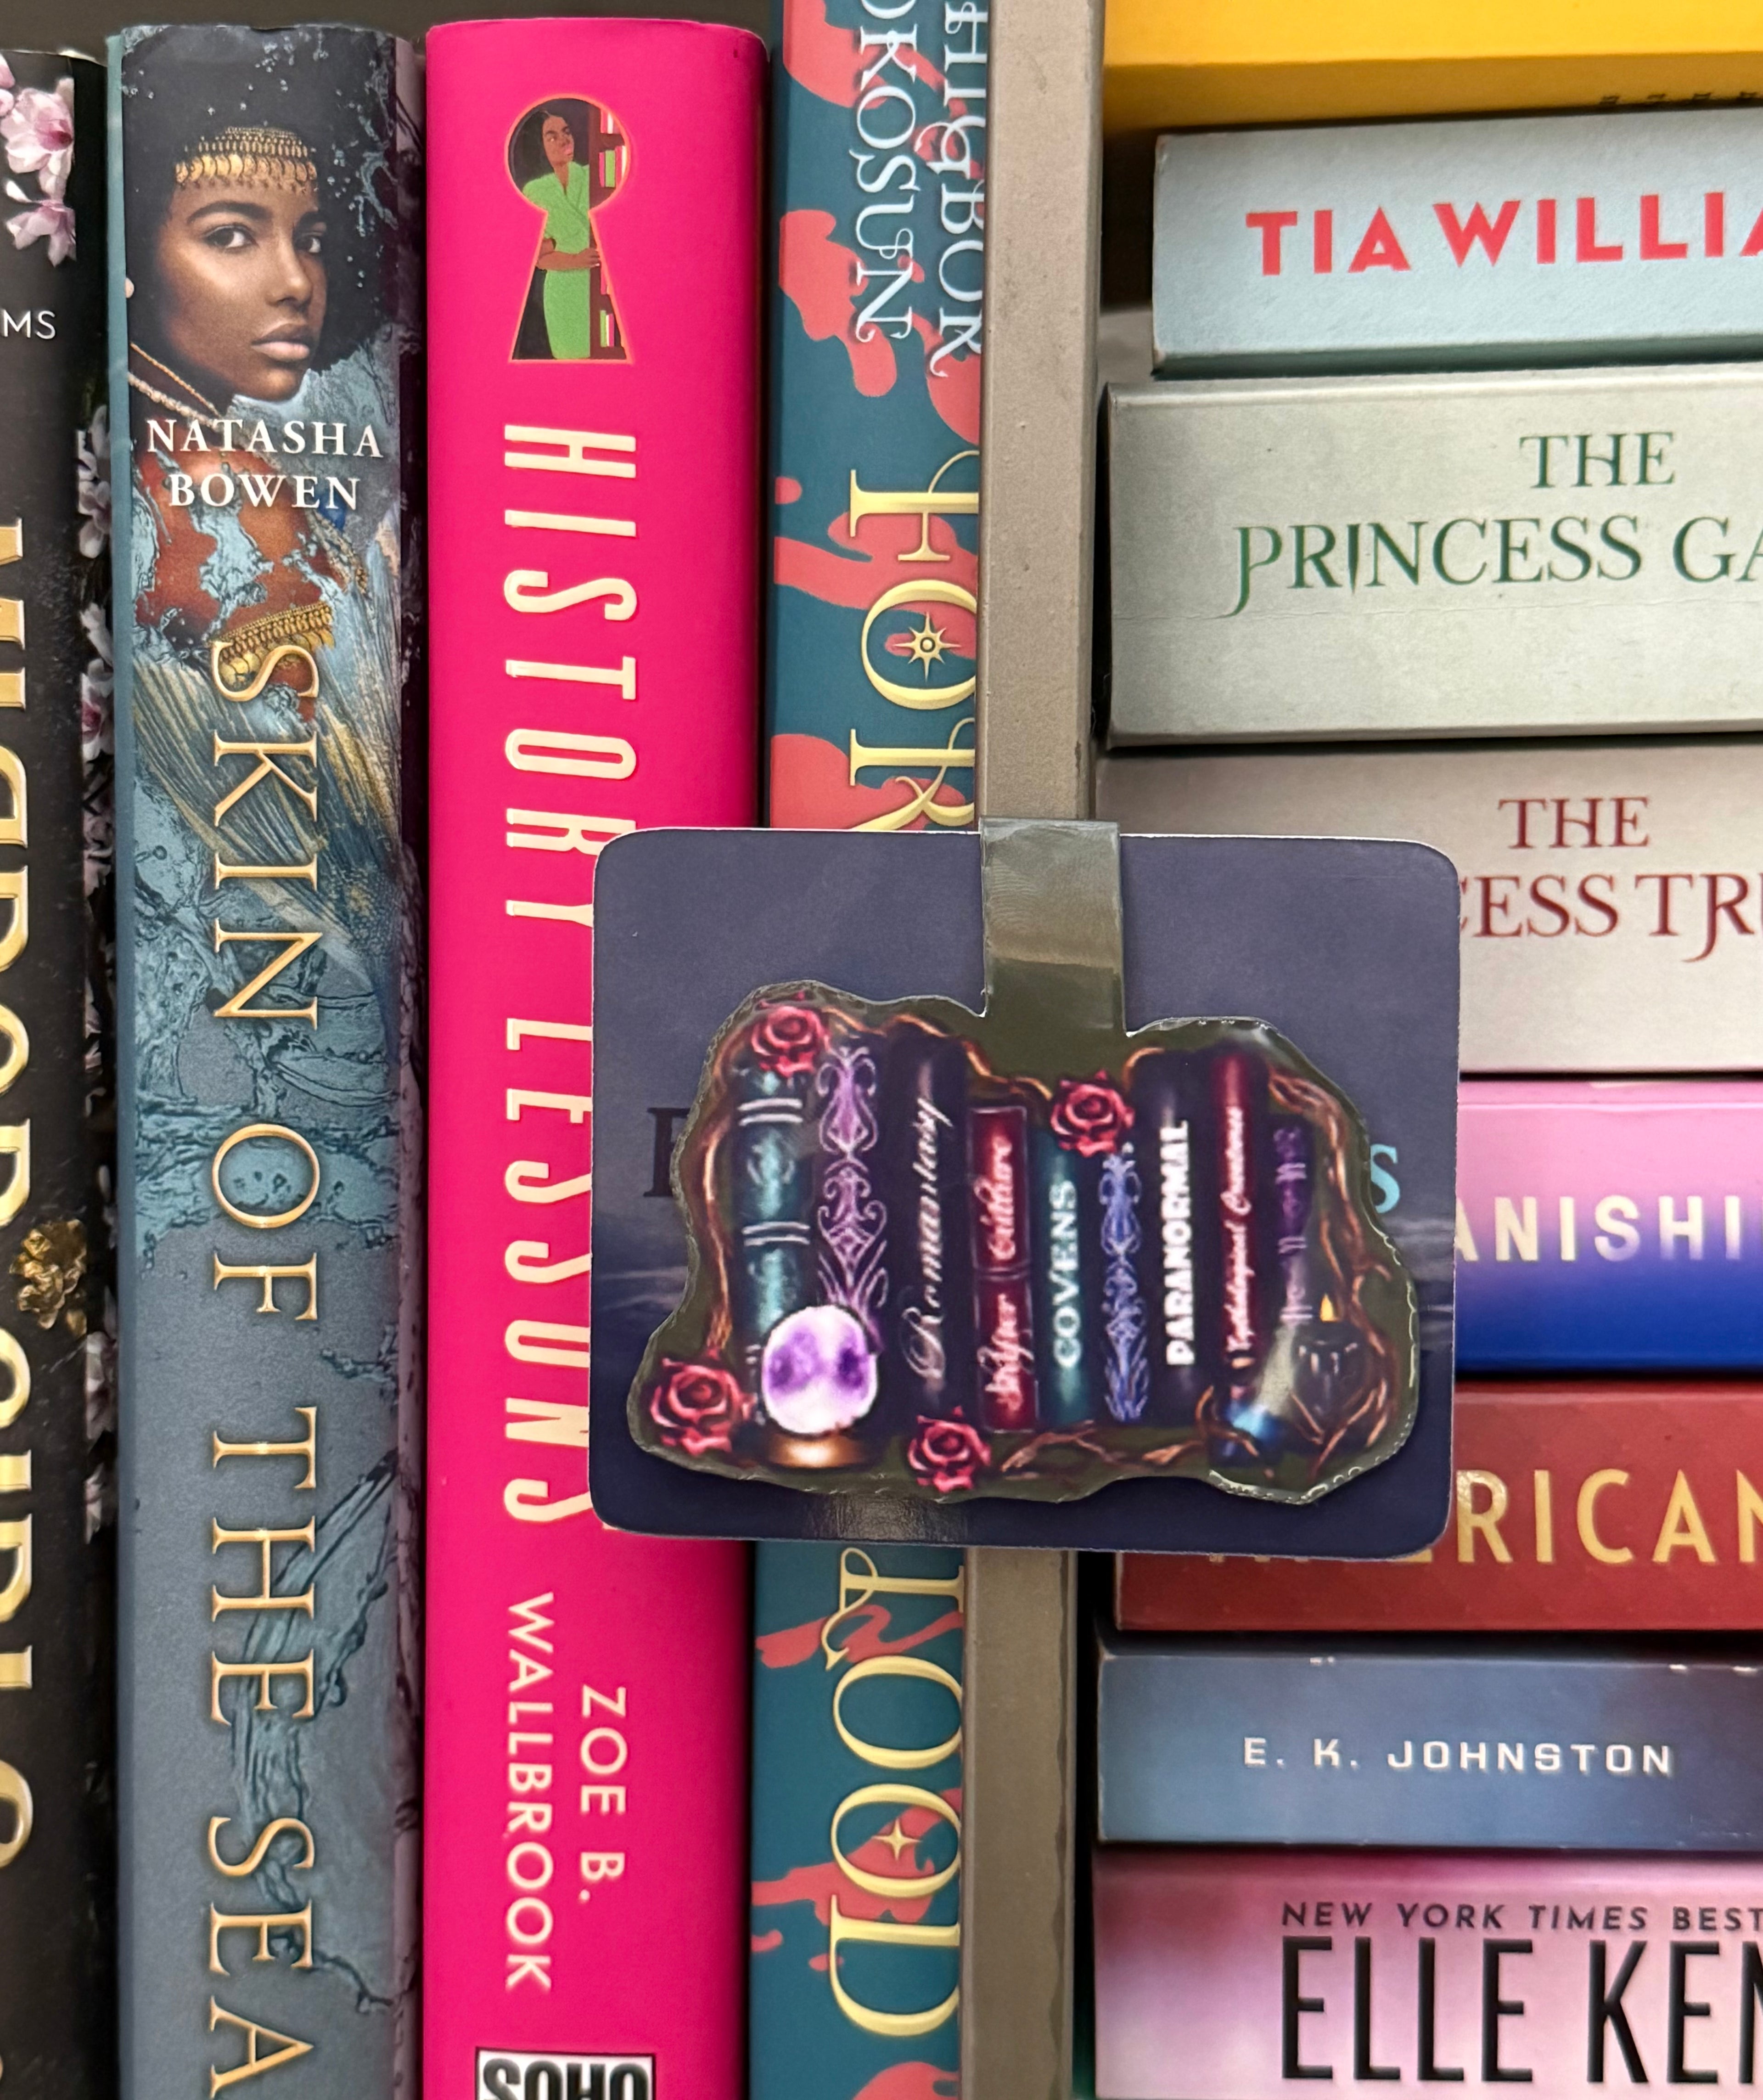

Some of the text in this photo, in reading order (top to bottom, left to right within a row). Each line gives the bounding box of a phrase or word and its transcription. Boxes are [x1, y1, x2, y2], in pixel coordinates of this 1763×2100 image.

[1246, 208, 1411, 276] TIA
[147, 419, 384, 458] NATASHA
[1519, 432, 1676, 489] THE
[169, 473, 360, 511] BOWEN
[1219, 514, 1643, 618] PRINCESS
[503, 424, 637, 928] HISTORY
[1499, 796, 1651, 849] THE
[1460, 873, 1619, 938] ESS
[1050, 1180, 1081, 1368] COVENS
[1160, 1120, 1195, 1366] PARANORMAL
[208, 641, 323, 2099] SKIN OF THE SEA
[505, 1592, 554, 1992] WALLBROOK
[579, 1684, 628, 1903] ZOE B.
[1243, 1737, 1672, 1775] E. K. JOHNSTON
[1282, 1901, 1373, 1927] NEW
[1398, 1903, 1505, 1928] YORK
[1529, 1906, 1647, 1930] TIMES
[1282, 1936, 1533, 2083] ELLE
